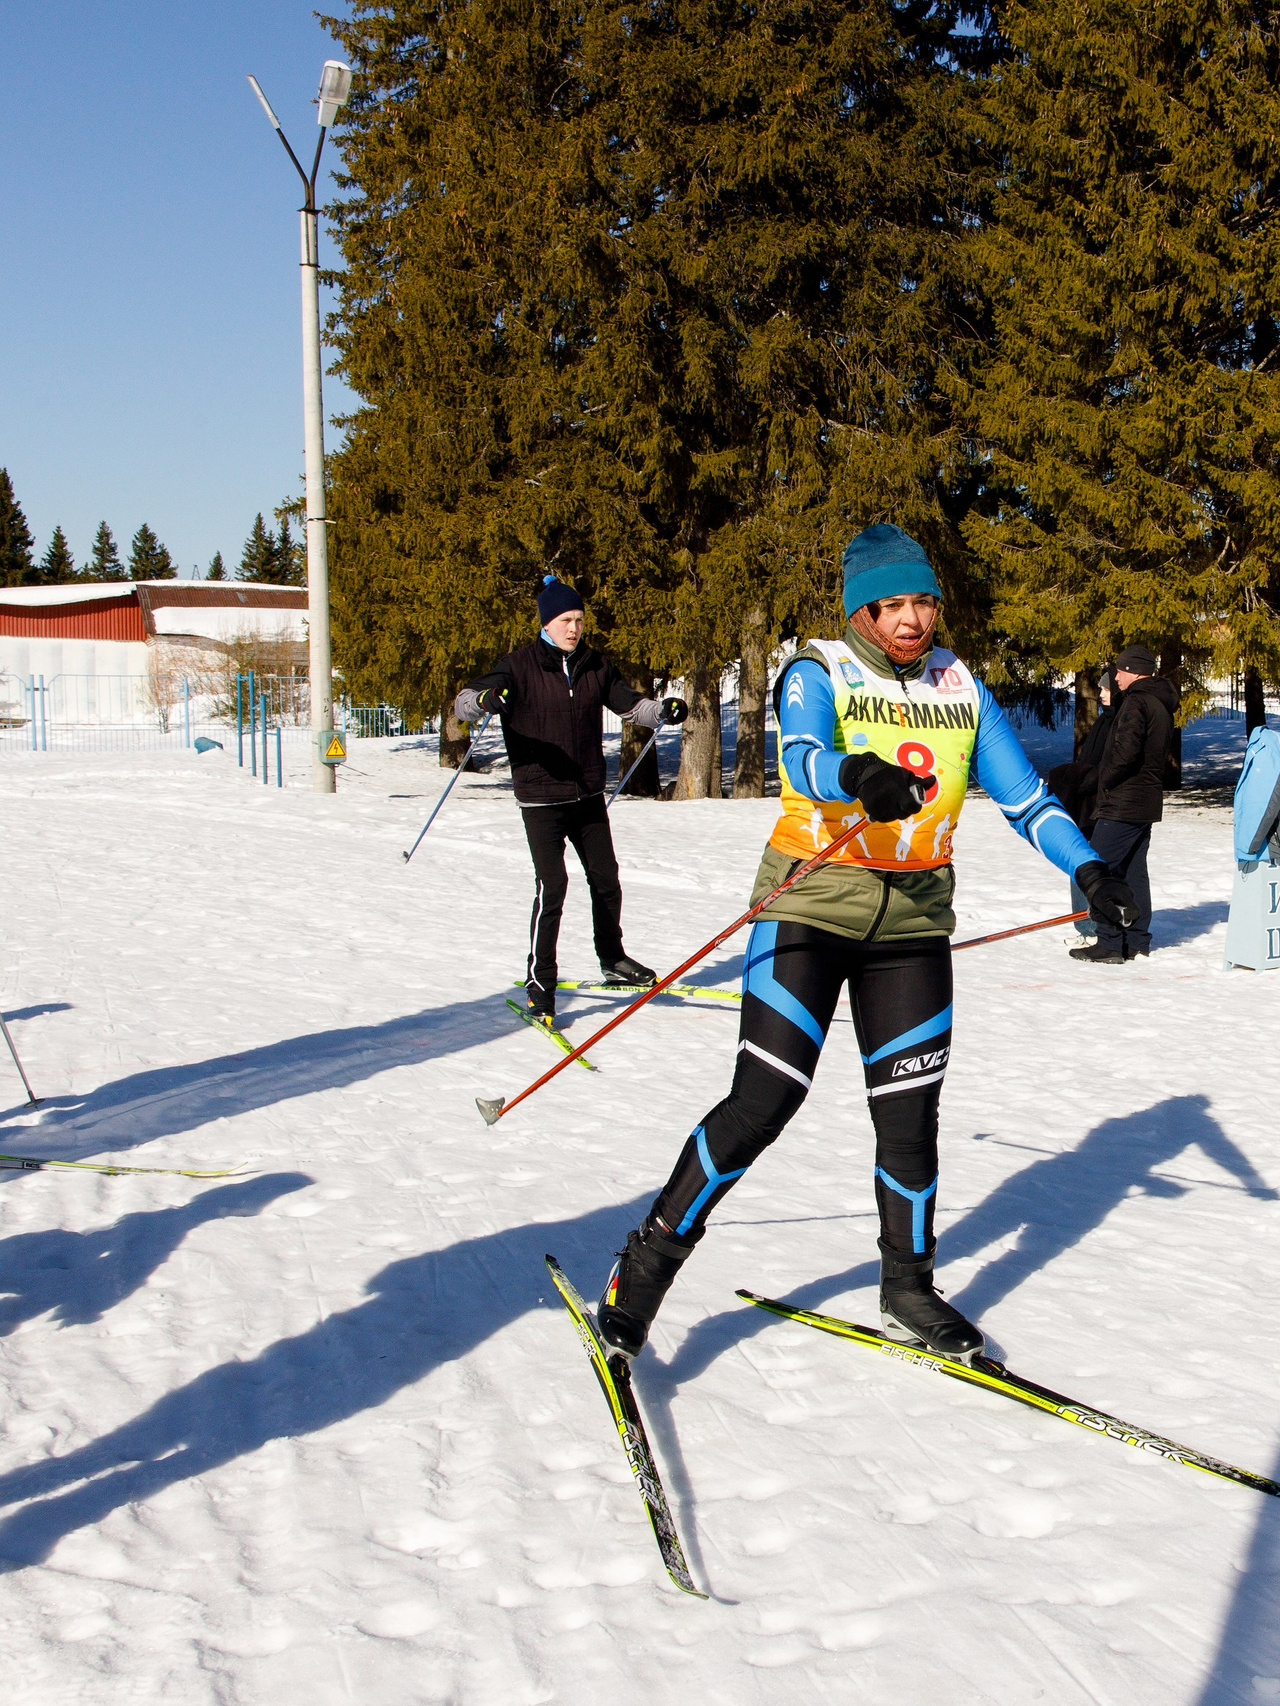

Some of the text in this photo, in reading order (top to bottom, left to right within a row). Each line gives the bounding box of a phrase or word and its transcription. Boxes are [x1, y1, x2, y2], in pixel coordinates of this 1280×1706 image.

[843, 695, 975, 730] AKKERMANN
[896, 741, 941, 805] 8
[880, 1343, 944, 1373] FISCHER
[619, 1418, 661, 1512] FISCHER
[1056, 1406, 1199, 1465] FISCHER
